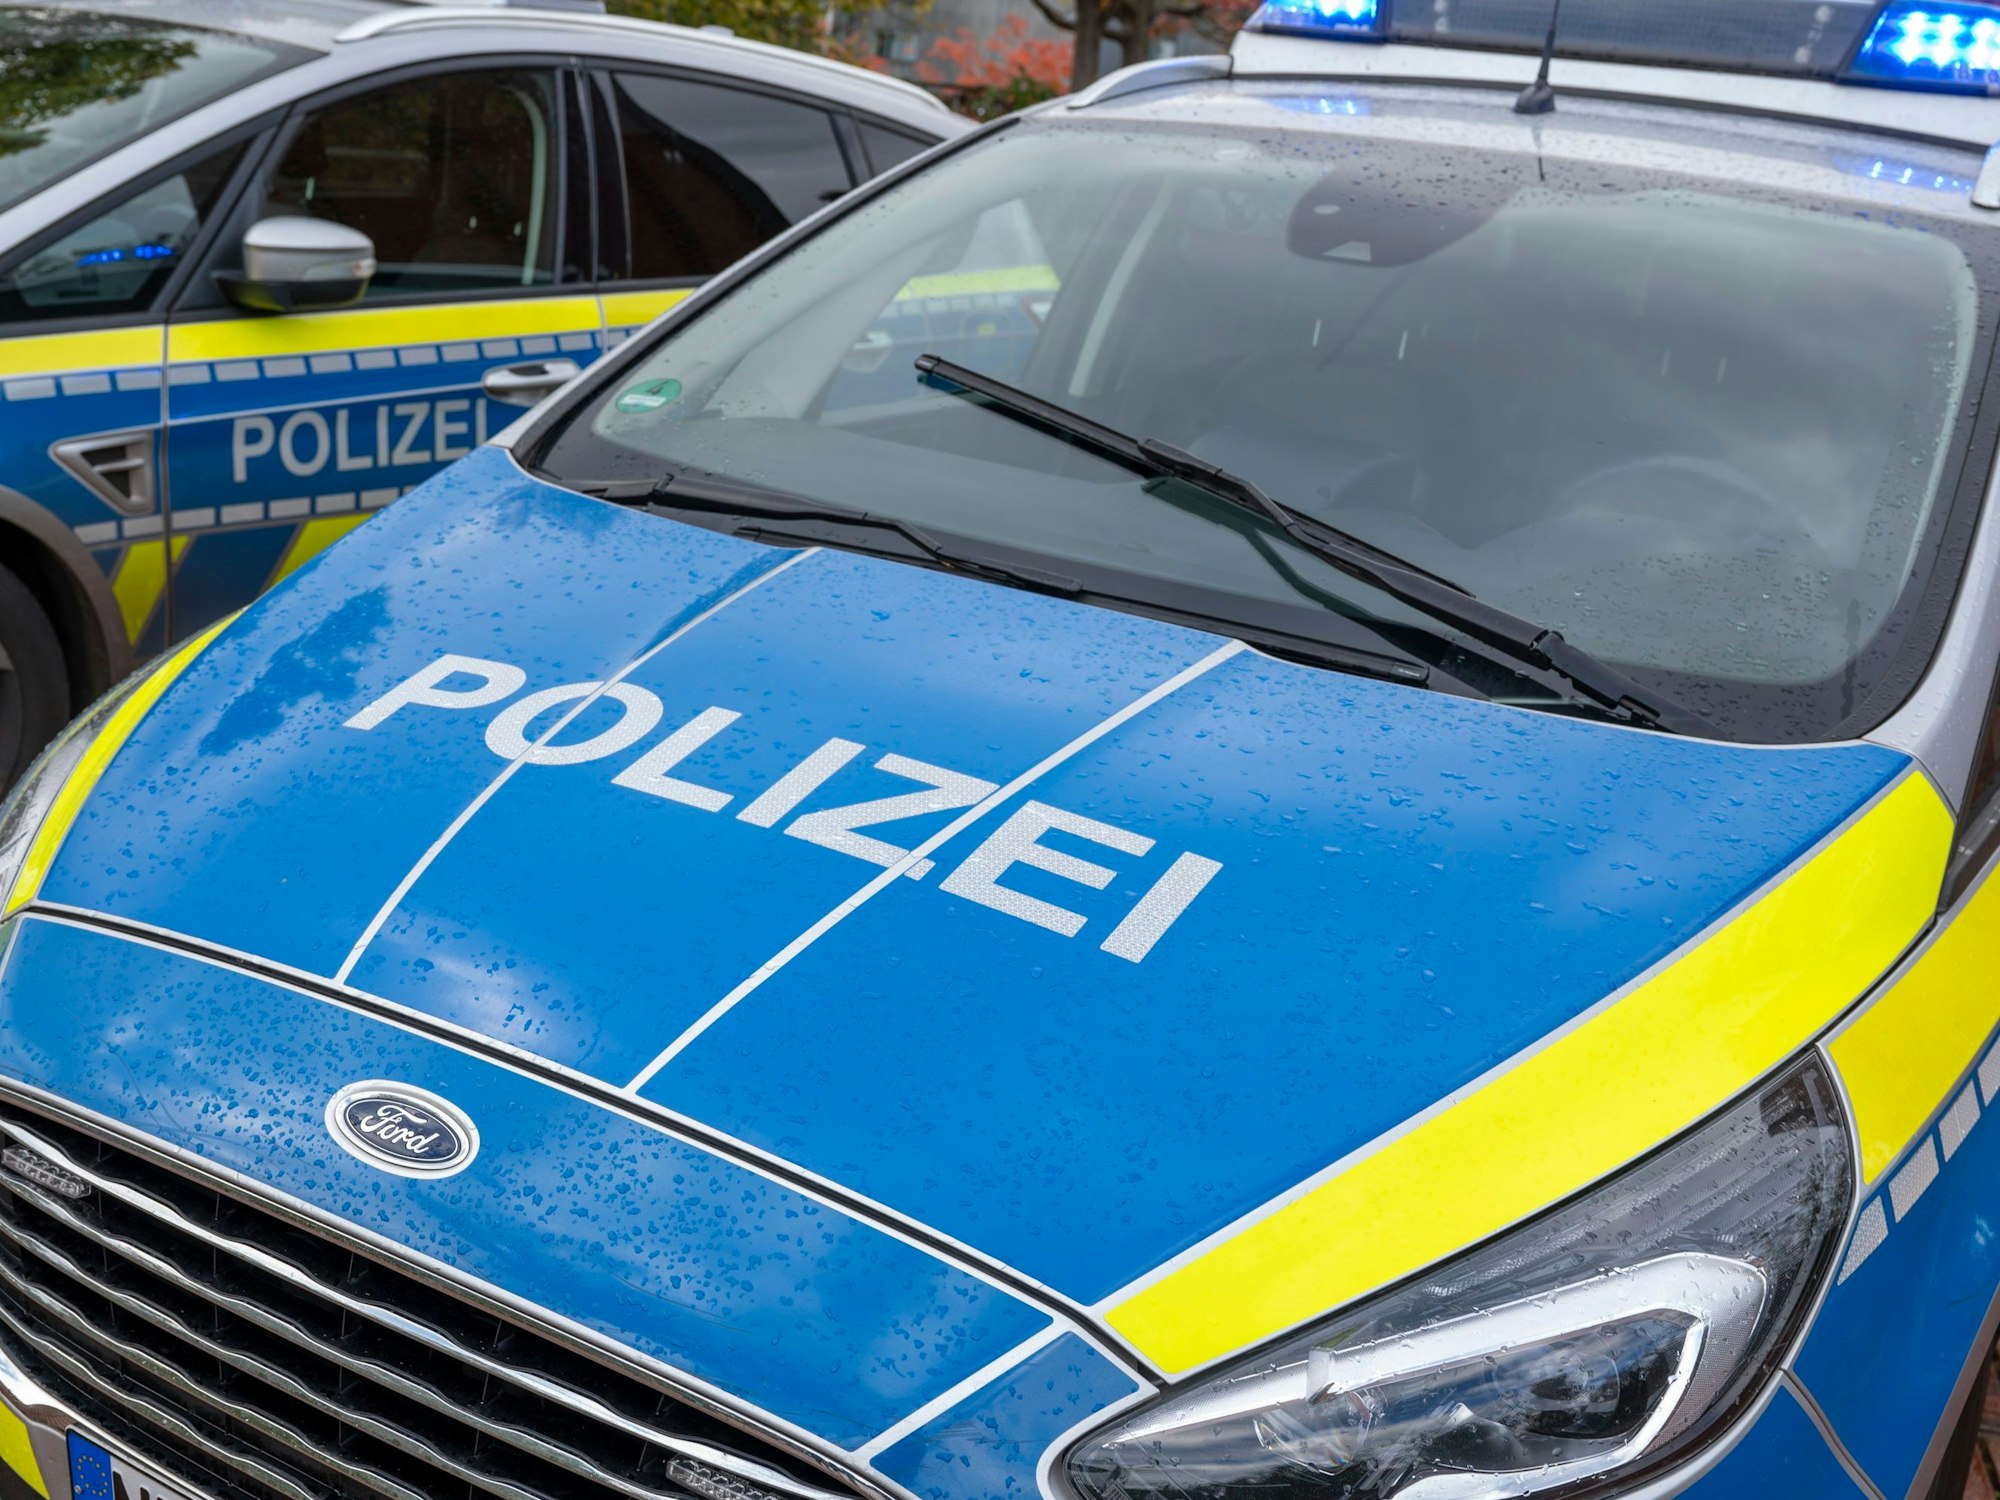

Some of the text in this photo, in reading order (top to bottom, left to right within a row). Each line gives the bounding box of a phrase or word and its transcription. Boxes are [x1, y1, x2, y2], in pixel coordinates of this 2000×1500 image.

[231, 398, 487, 483] POLIZEI
[342, 653, 1223, 964] POLIZEI
[360, 1104, 440, 1154] Ford
